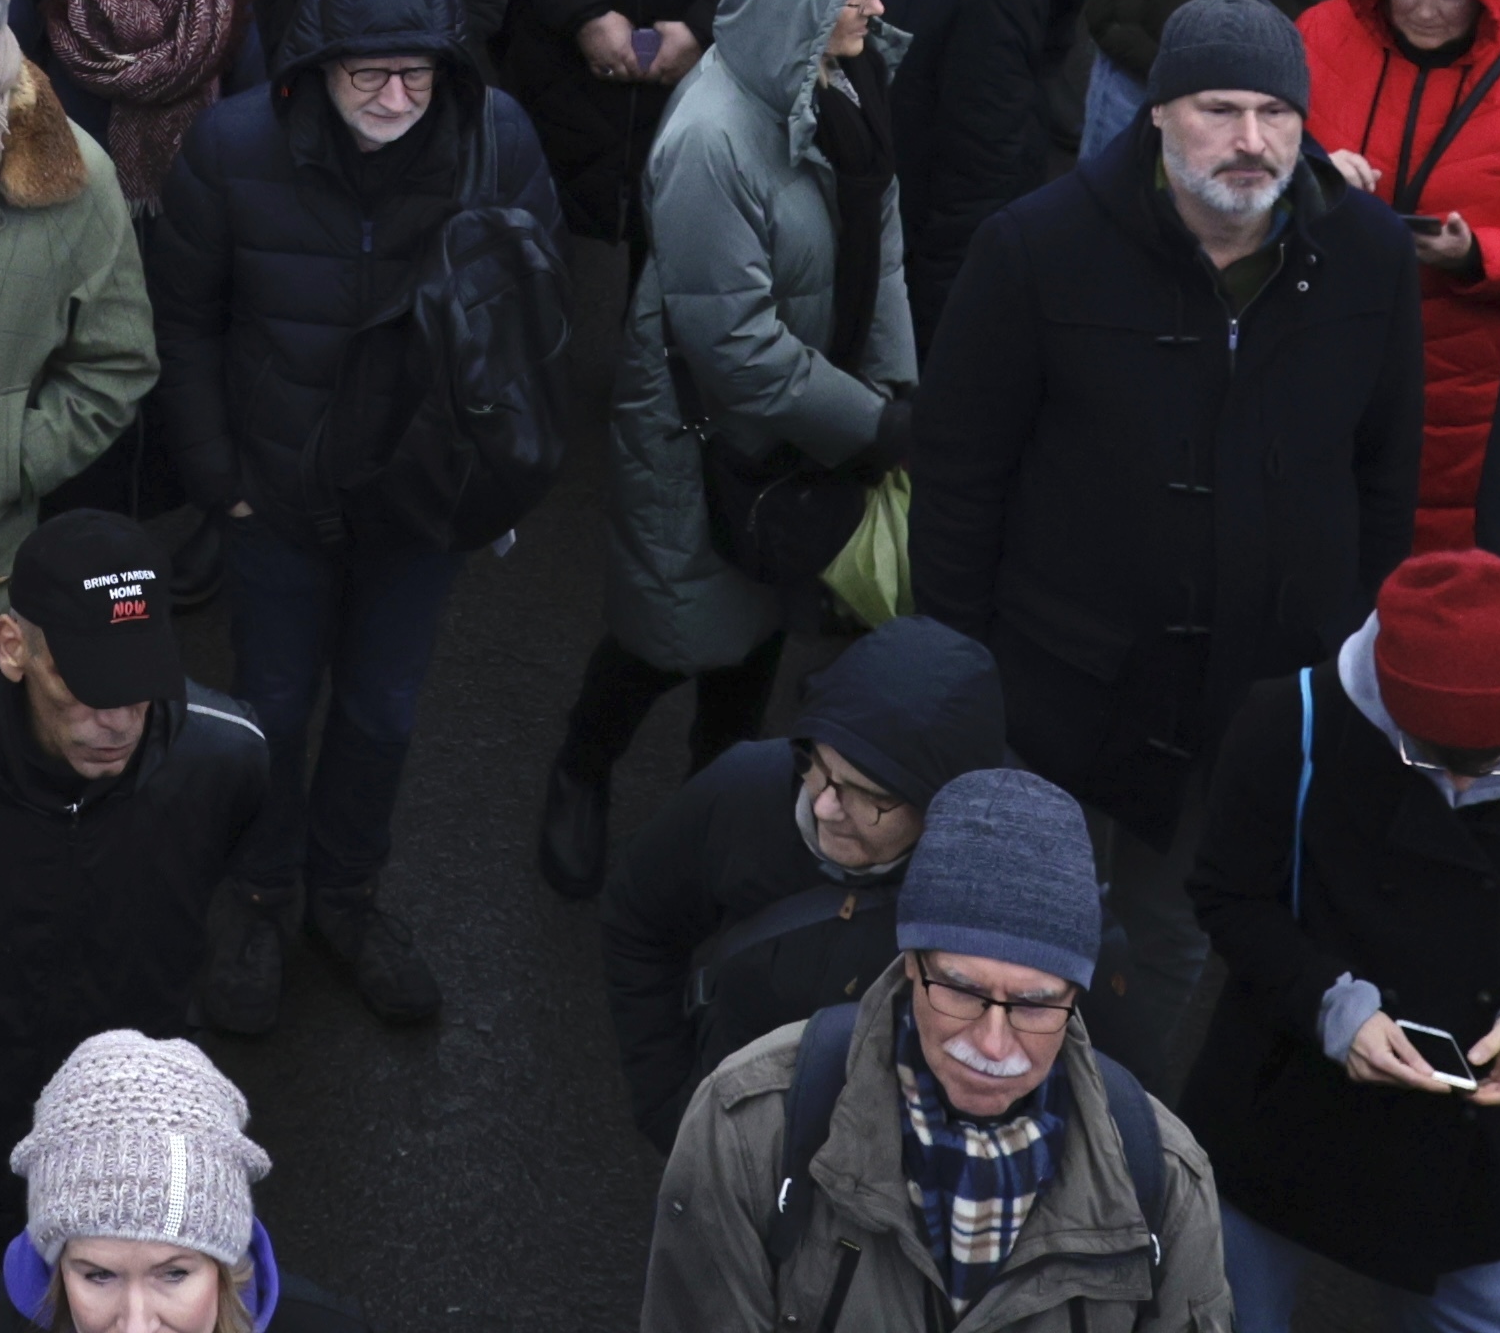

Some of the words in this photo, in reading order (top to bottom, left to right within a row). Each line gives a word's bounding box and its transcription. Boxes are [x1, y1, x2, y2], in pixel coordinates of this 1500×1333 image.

[83, 573, 119, 590] BRING
[120, 569, 157, 582] YARDEN
[109, 584, 143, 600] HOME
[112, 599, 147, 619] NOW
